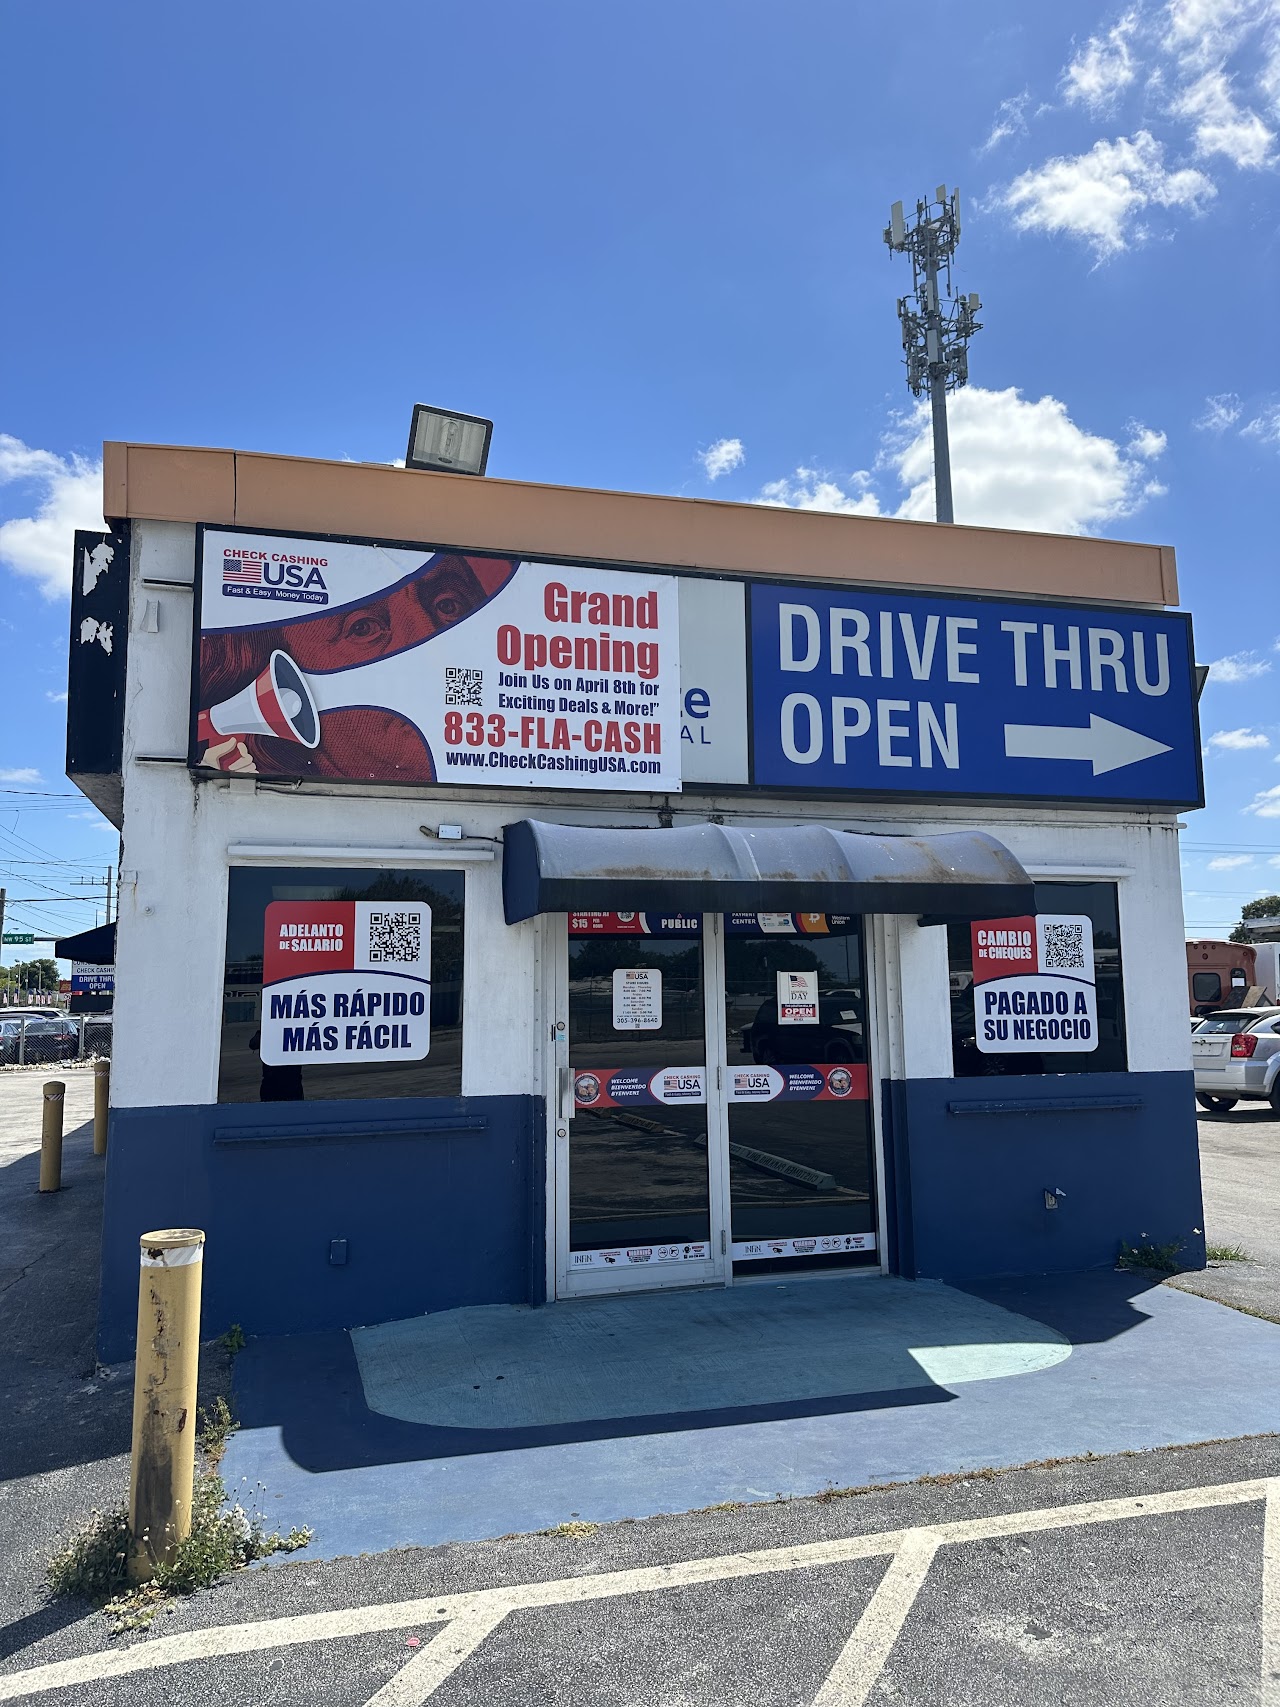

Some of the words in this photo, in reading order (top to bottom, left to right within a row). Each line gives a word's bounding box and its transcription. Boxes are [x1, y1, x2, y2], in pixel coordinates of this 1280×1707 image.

[223, 549, 267, 560] CHECK
[271, 554, 328, 566] CASHING
[263, 562, 327, 590] USA
[253, 588, 272, 598] Easy
[276, 590, 300, 600] Money
[302, 592, 324, 602] Today
[544, 582, 658, 629] Grand
[497, 624, 659, 680] Opening
[778, 603, 980, 684] DRIVE
[1001, 620, 1170, 697] THRU
[499, 672, 528, 688] Join
[532, 674, 550, 690] Us
[554, 678, 572, 690] on
[576, 677, 608, 694] April
[614, 679, 636, 694] 8th
[640, 682, 660, 696] for
[499, 694, 556, 712] Exciting
[559, 698, 598, 714] Deals
[602, 702, 612, 714] &
[444, 711, 661, 754] 833-FLA-CASH
[780, 692, 960, 770] OPEN
[446, 751, 661, 774] www.CheckCashingUSA.com
[280, 924, 344, 938] ADELANTO
[572, 918, 588, 929] $15
[661, 918, 698, 928] PUBLIC
[280, 941, 290, 950] DE
[291, 938, 343, 952] SALARIO
[978, 930, 1032, 946] CAMBIO
[979, 949, 988, 958] DE
[989, 948, 1032, 960] CHEQUES
[270, 990, 326, 1019] MÁS
[334, 988, 424, 1017] RÁPIDO
[984, 991, 1068, 1015] PAGADO
[1074, 992, 1088, 1015] A
[282, 1022, 338, 1052] MÁS
[346, 1020, 412, 1050] FÁCIL
[984, 1019, 1008, 1040] SU
[1013, 1018, 1091, 1040] NEGOCIO
[678, 1080, 701, 1089] USA
[748, 1078, 770, 1088] USA
